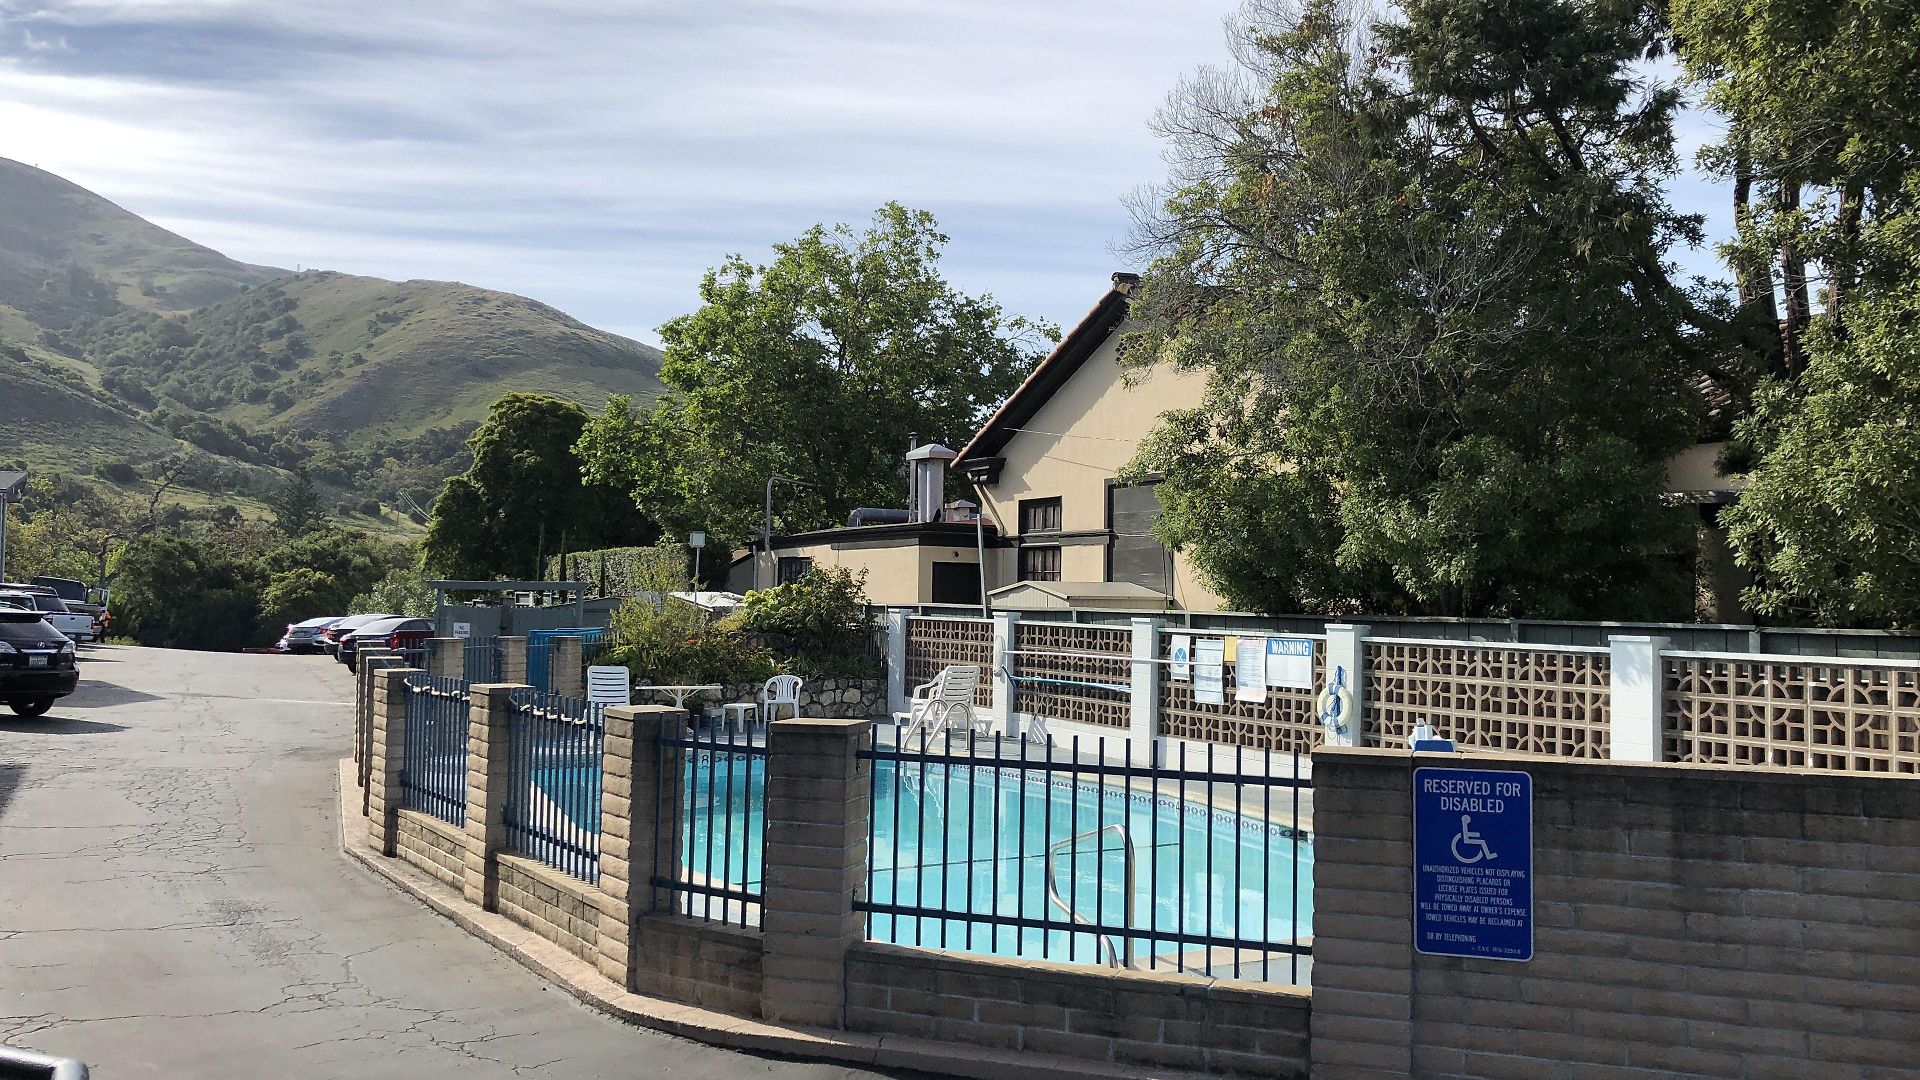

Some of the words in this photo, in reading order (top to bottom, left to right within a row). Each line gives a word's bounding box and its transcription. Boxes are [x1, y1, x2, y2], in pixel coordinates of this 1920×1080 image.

[1272, 640, 1309, 655] WARNING
[1424, 779, 1490, 795] RESERVED
[1496, 782, 1520, 796] FOR
[1441, 797, 1504, 813] DISABLED
[1423, 864, 1459, 874] UNAUTHORIZED
[1461, 866, 1484, 875] VEHICLES
[1486, 868, 1495, 876] NOT
[1497, 869, 1525, 878] DISPLAYING
[1437, 875, 1474, 884] DISTINGUISHING
[1476, 878, 1501, 886] PLACARDS
[1460, 886, 1477, 894] PLATES
[1479, 887, 1496, 895] ISSUED
[1435, 894, 1463, 903] PHYSICALLY
[1465, 896, 1488, 904] DISABLED
[1490, 897, 1512, 905] PERSONS
[1421, 902, 1431, 910] WILL
[1441, 903, 1457, 911] TOWED
[1459, 904, 1471, 912] AWAY
[1481, 906, 1502, 914] OWNER'S
[1425, 913, 1441, 921] TOWED
[1443, 914, 1466, 923] VEHICLES
[1468, 916, 1477, 924] MAY
[1480, 916, 1485, 924] BE
[1488, 917, 1515, 926] RECLAIMED
[1427, 932, 1434, 940] OR
[1436, 932, 1442, 940] BY
[1444, 933, 1476, 943] TELEPHONING
